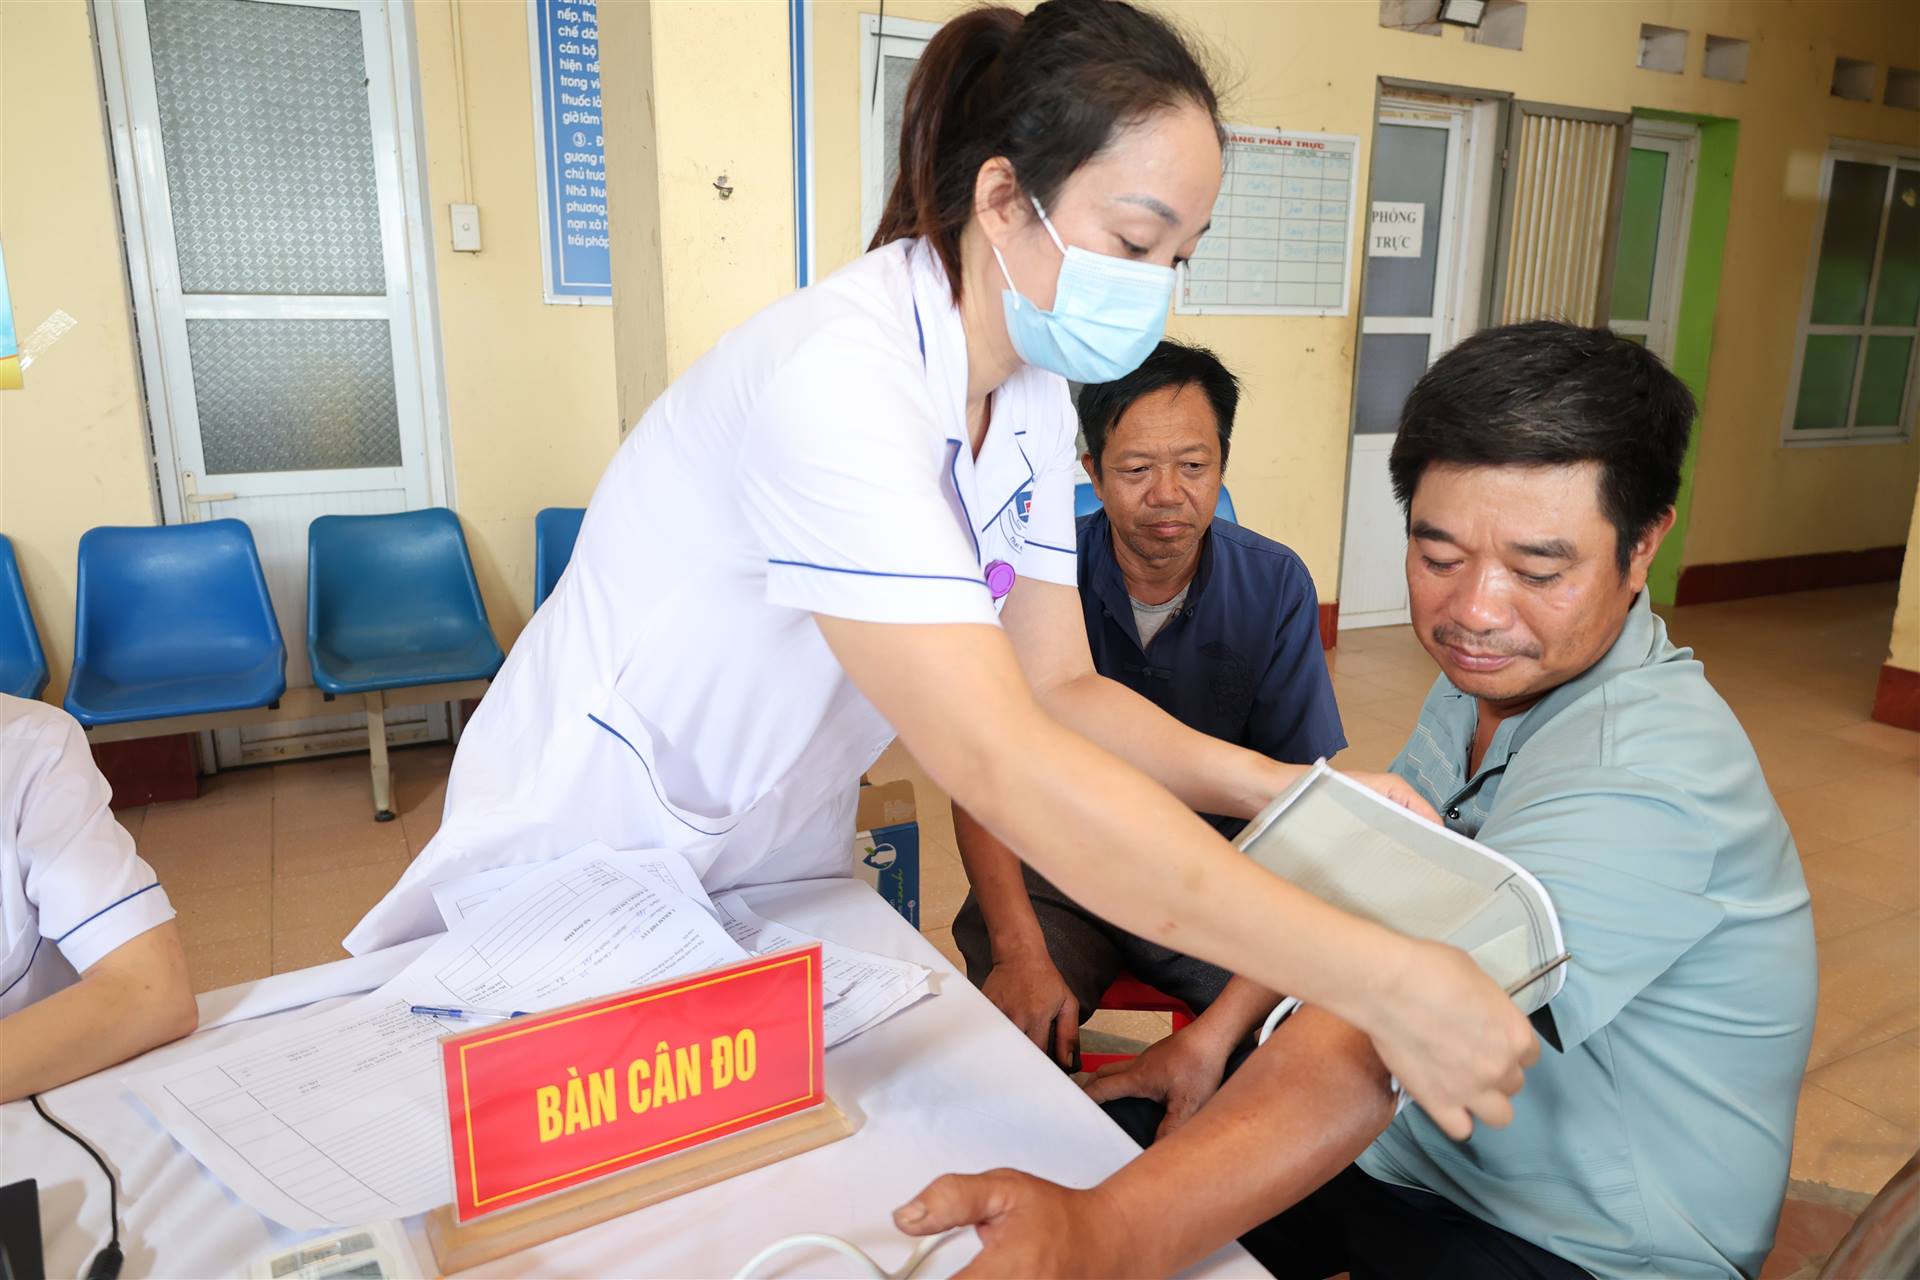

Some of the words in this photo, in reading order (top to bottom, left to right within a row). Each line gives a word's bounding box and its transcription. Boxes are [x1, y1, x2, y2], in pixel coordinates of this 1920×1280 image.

[558, 25, 578, 37] chế
[559, 41, 579, 54] cán
[582, 45, 597, 59] bộ
[560, 58, 583, 72] hiện
[560, 75, 588, 91] trong
[561, 93, 591, 107] thuốc
[565, 184, 587, 196] Nhà
[567, 233, 584, 246] trái
[535, 1066, 618, 1143] BÀN
[627, 1041, 702, 1115] CÂN
[710, 1028, 757, 1090] ĐO
